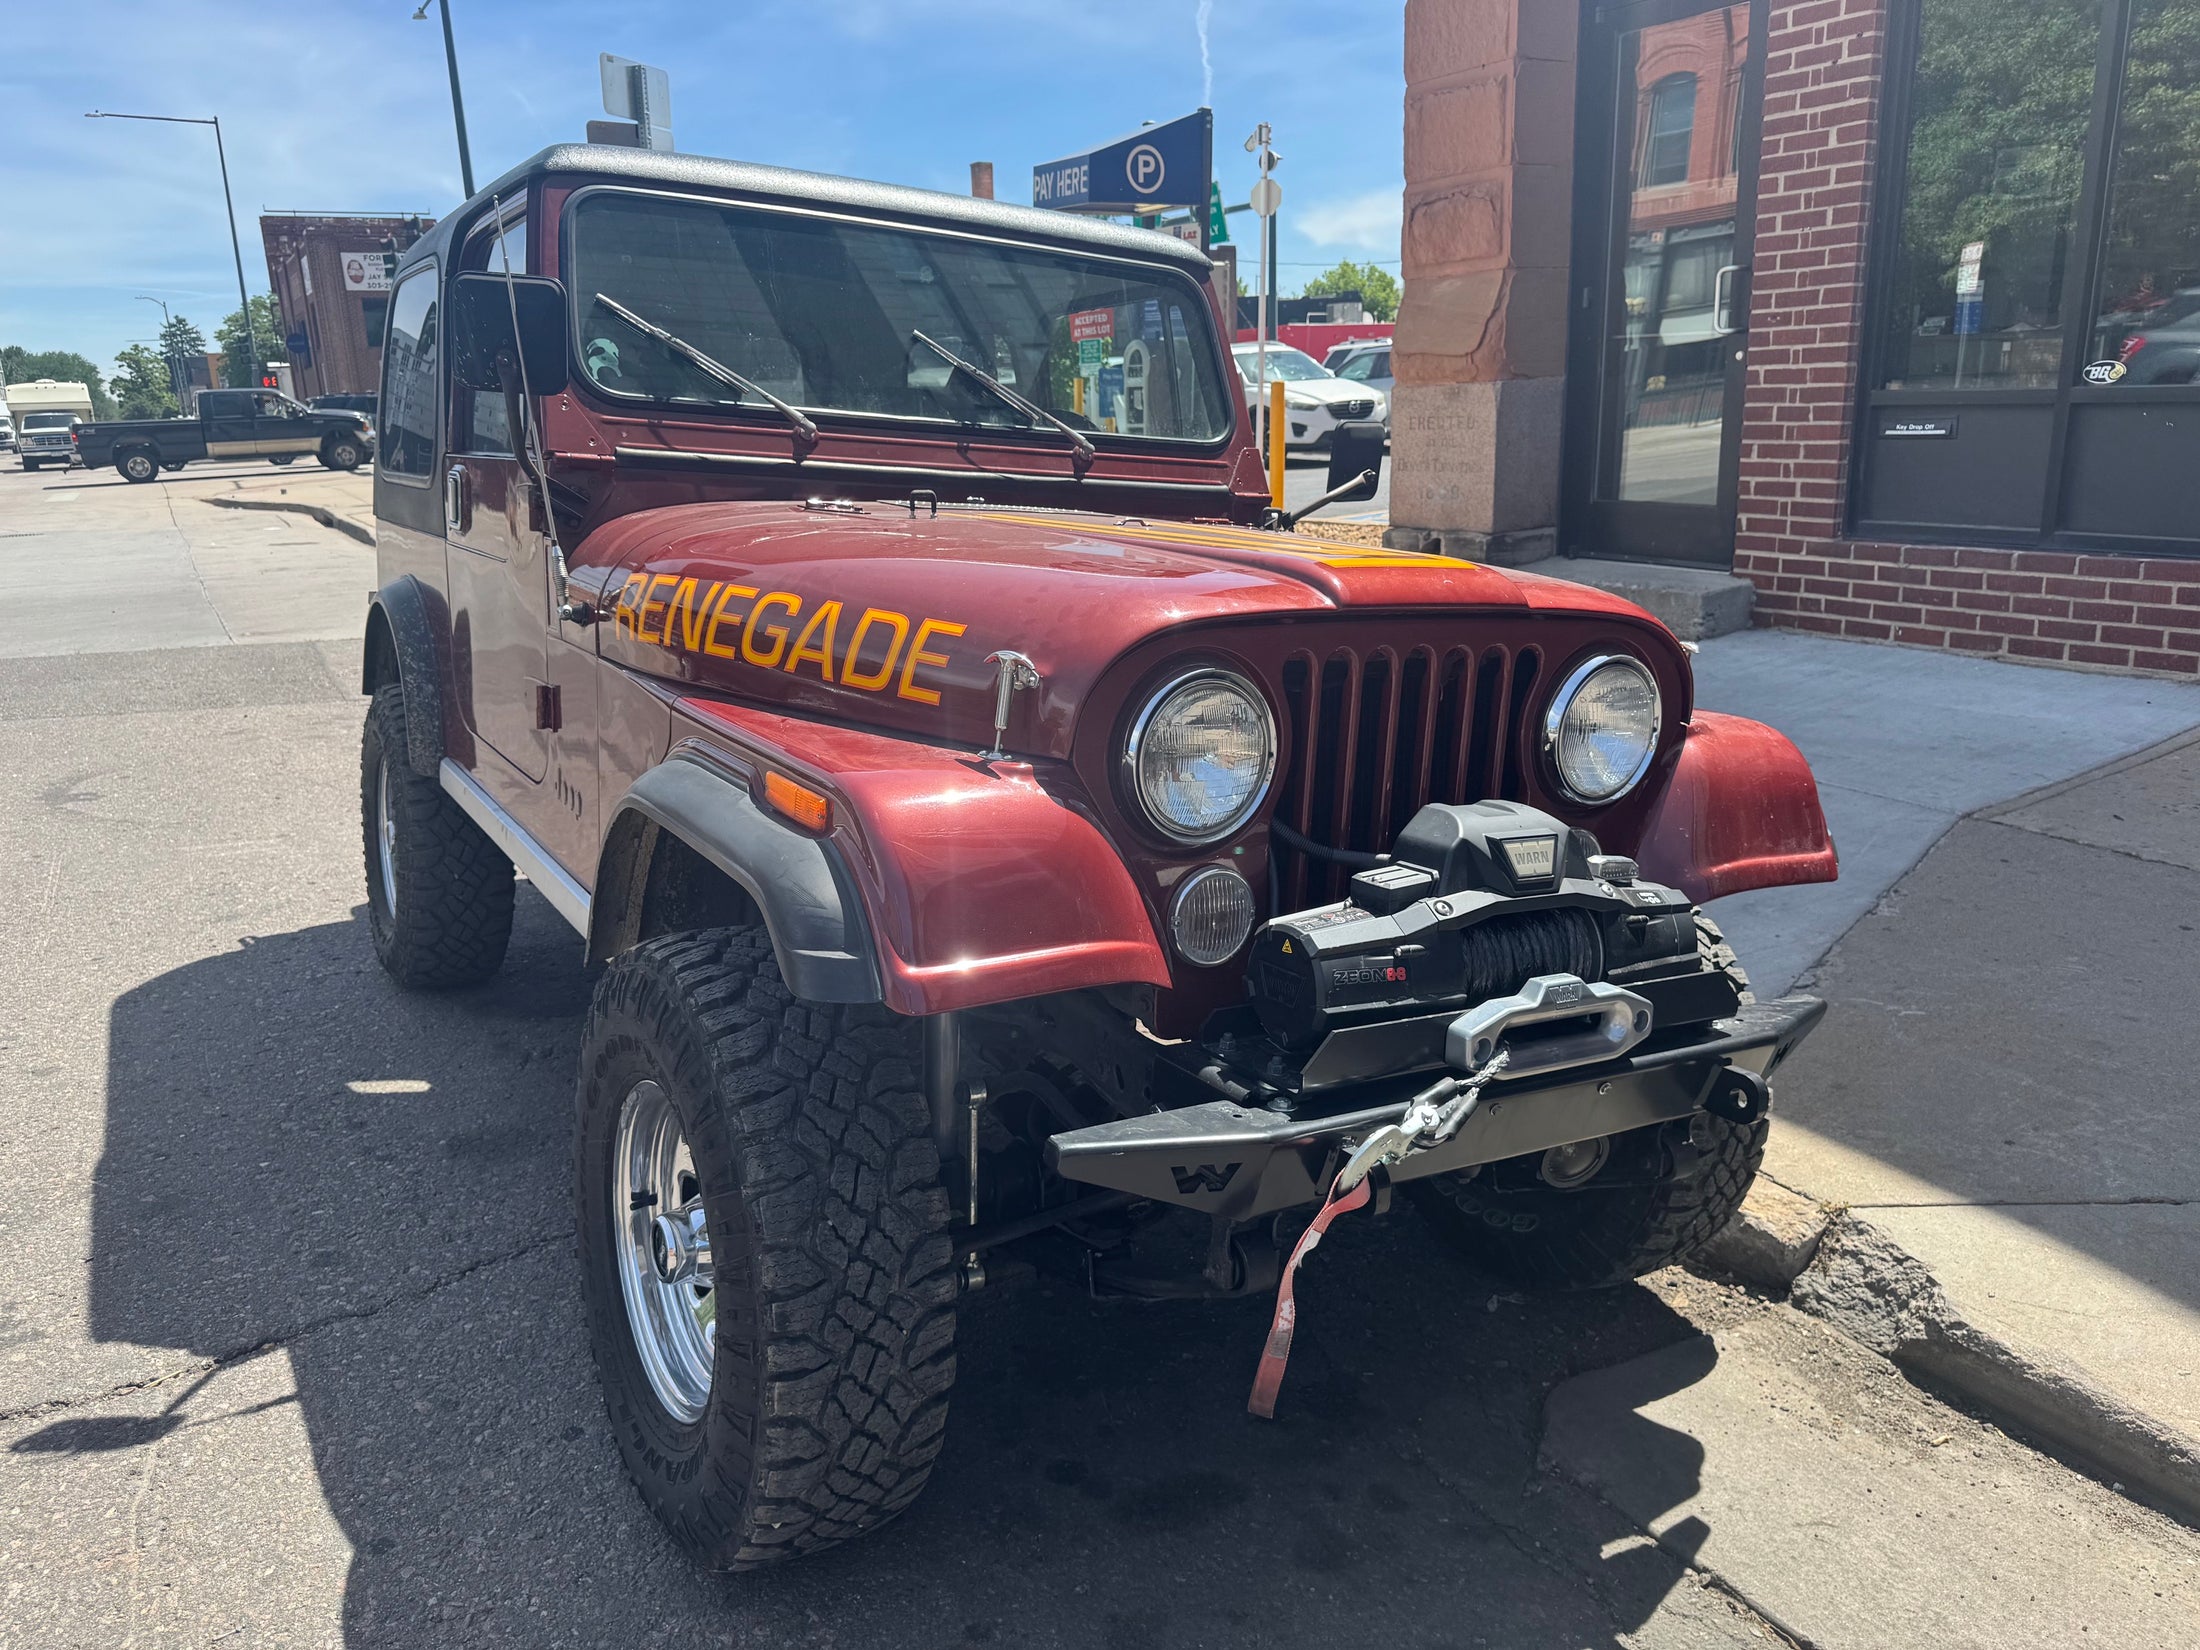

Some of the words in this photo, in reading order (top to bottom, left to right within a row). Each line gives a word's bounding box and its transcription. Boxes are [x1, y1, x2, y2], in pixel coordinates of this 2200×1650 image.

[1137, 154, 1156, 184] P
[1034, 171, 1055, 201] PAY
[1057, 164, 1089, 198] HERE
[1074, 313, 1108, 326] ACCEPTED
[1082, 326, 1097, 336] THIS
[1097, 324, 1111, 335] LOT
[2089, 365, 2112, 379] BG
[1895, 423, 1907, 431] Key
[615, 573, 968, 706] RENEGADE
[1515, 850, 1550, 866] WARN
